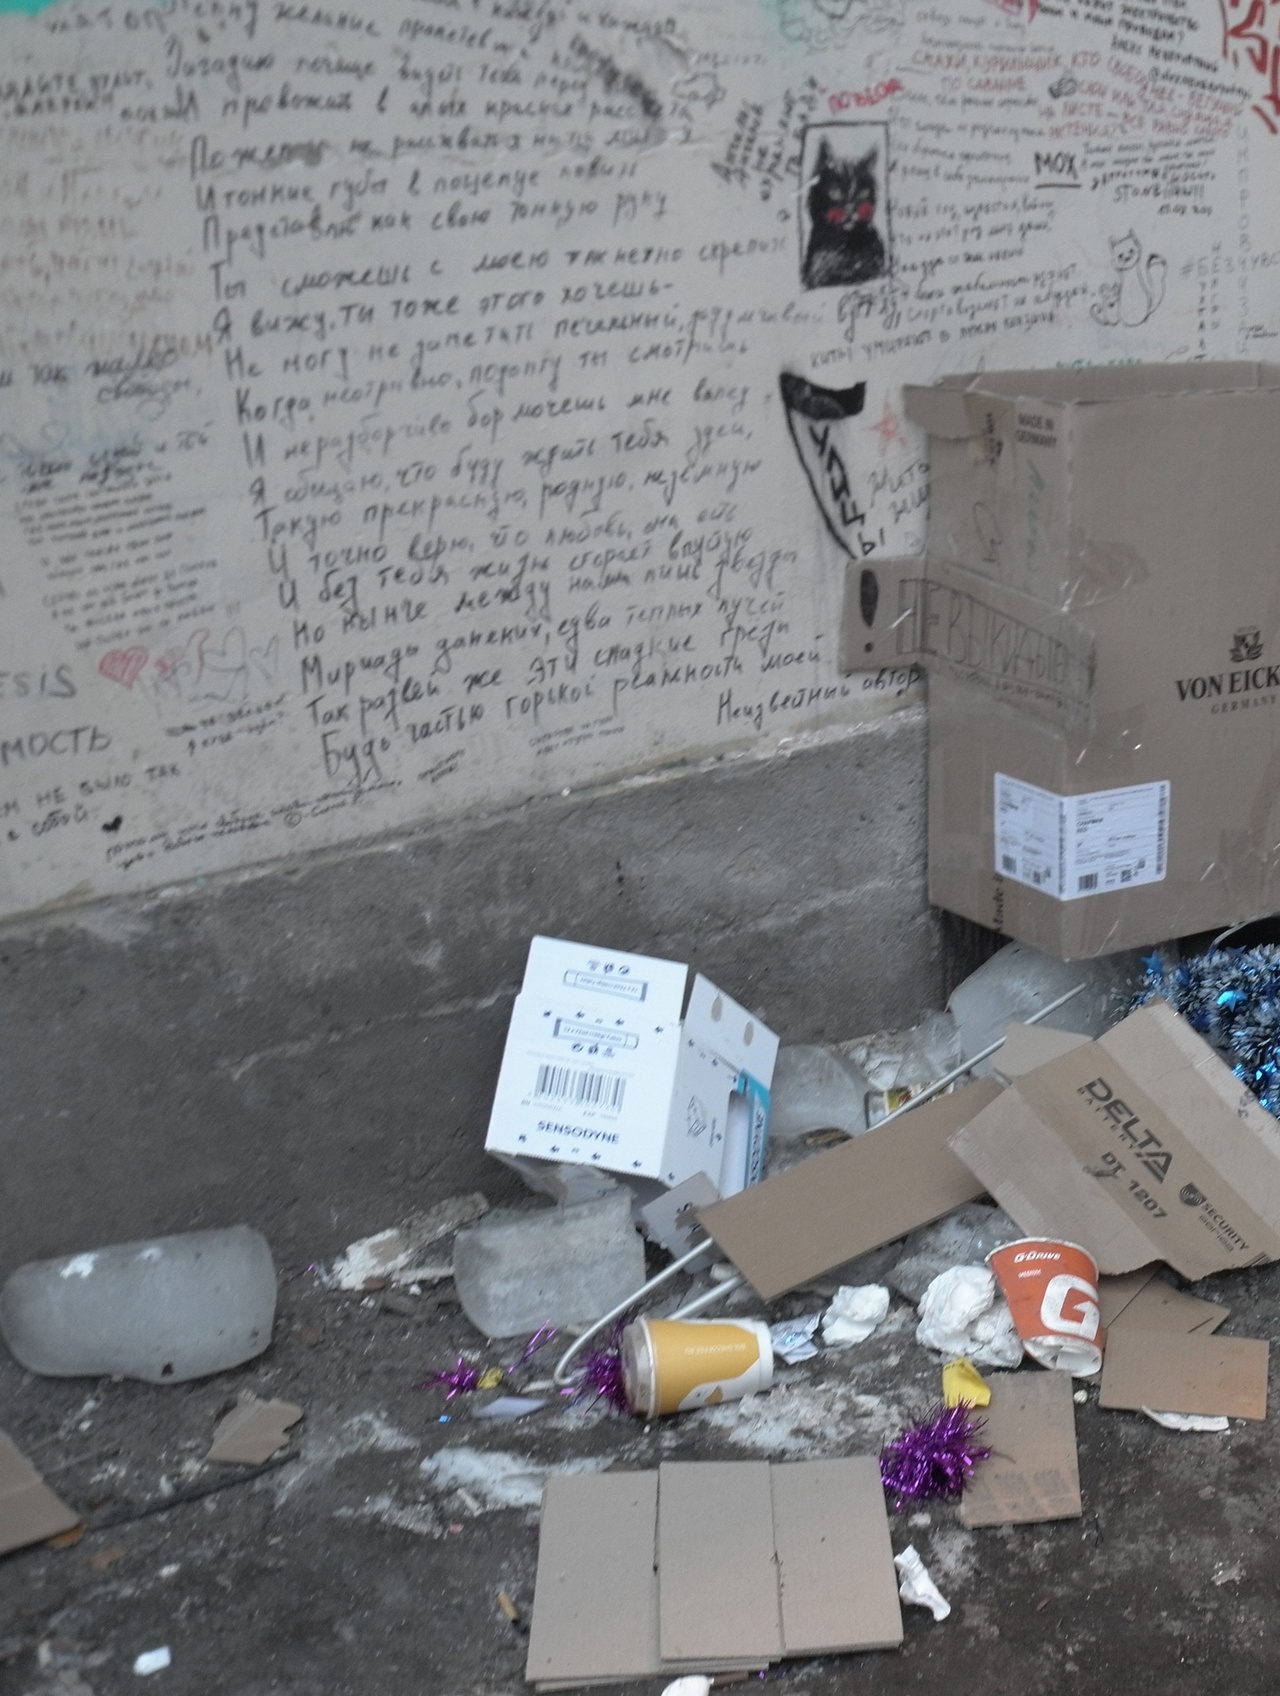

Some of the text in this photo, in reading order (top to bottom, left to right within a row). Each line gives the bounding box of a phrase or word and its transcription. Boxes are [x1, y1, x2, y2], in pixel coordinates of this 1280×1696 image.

[407, 167, 421, 196] в
[208, 258, 247, 302] Ты
[212, 305, 234, 347] Я
[390, 293, 461, 322] тоже
[224, 344, 264, 382] Не
[368, 342, 401, 363] не
[241, 430, 266, 470] И
[247, 474, 267, 507] Я
[450, 442, 505, 490] буду
[610, 417, 670, 451] тебя
[252, 504, 343, 553] Такую
[306, 542, 390, 575] точно
[277, 576, 301, 613] И
[291, 618, 326, 652] Но
[304, 692, 350, 729] Так
[462, 667, 503, 695] же
[1175, 674, 1223, 702] VON
[405, 702, 486, 745] частью
[536, 1119, 621, 1145] SENSODYNE
[1084, 1076, 1173, 1184] DELTA
[1128, 1179, 1168, 1220] 1207
[1200, 1201, 1249, 1252] SECURITY
